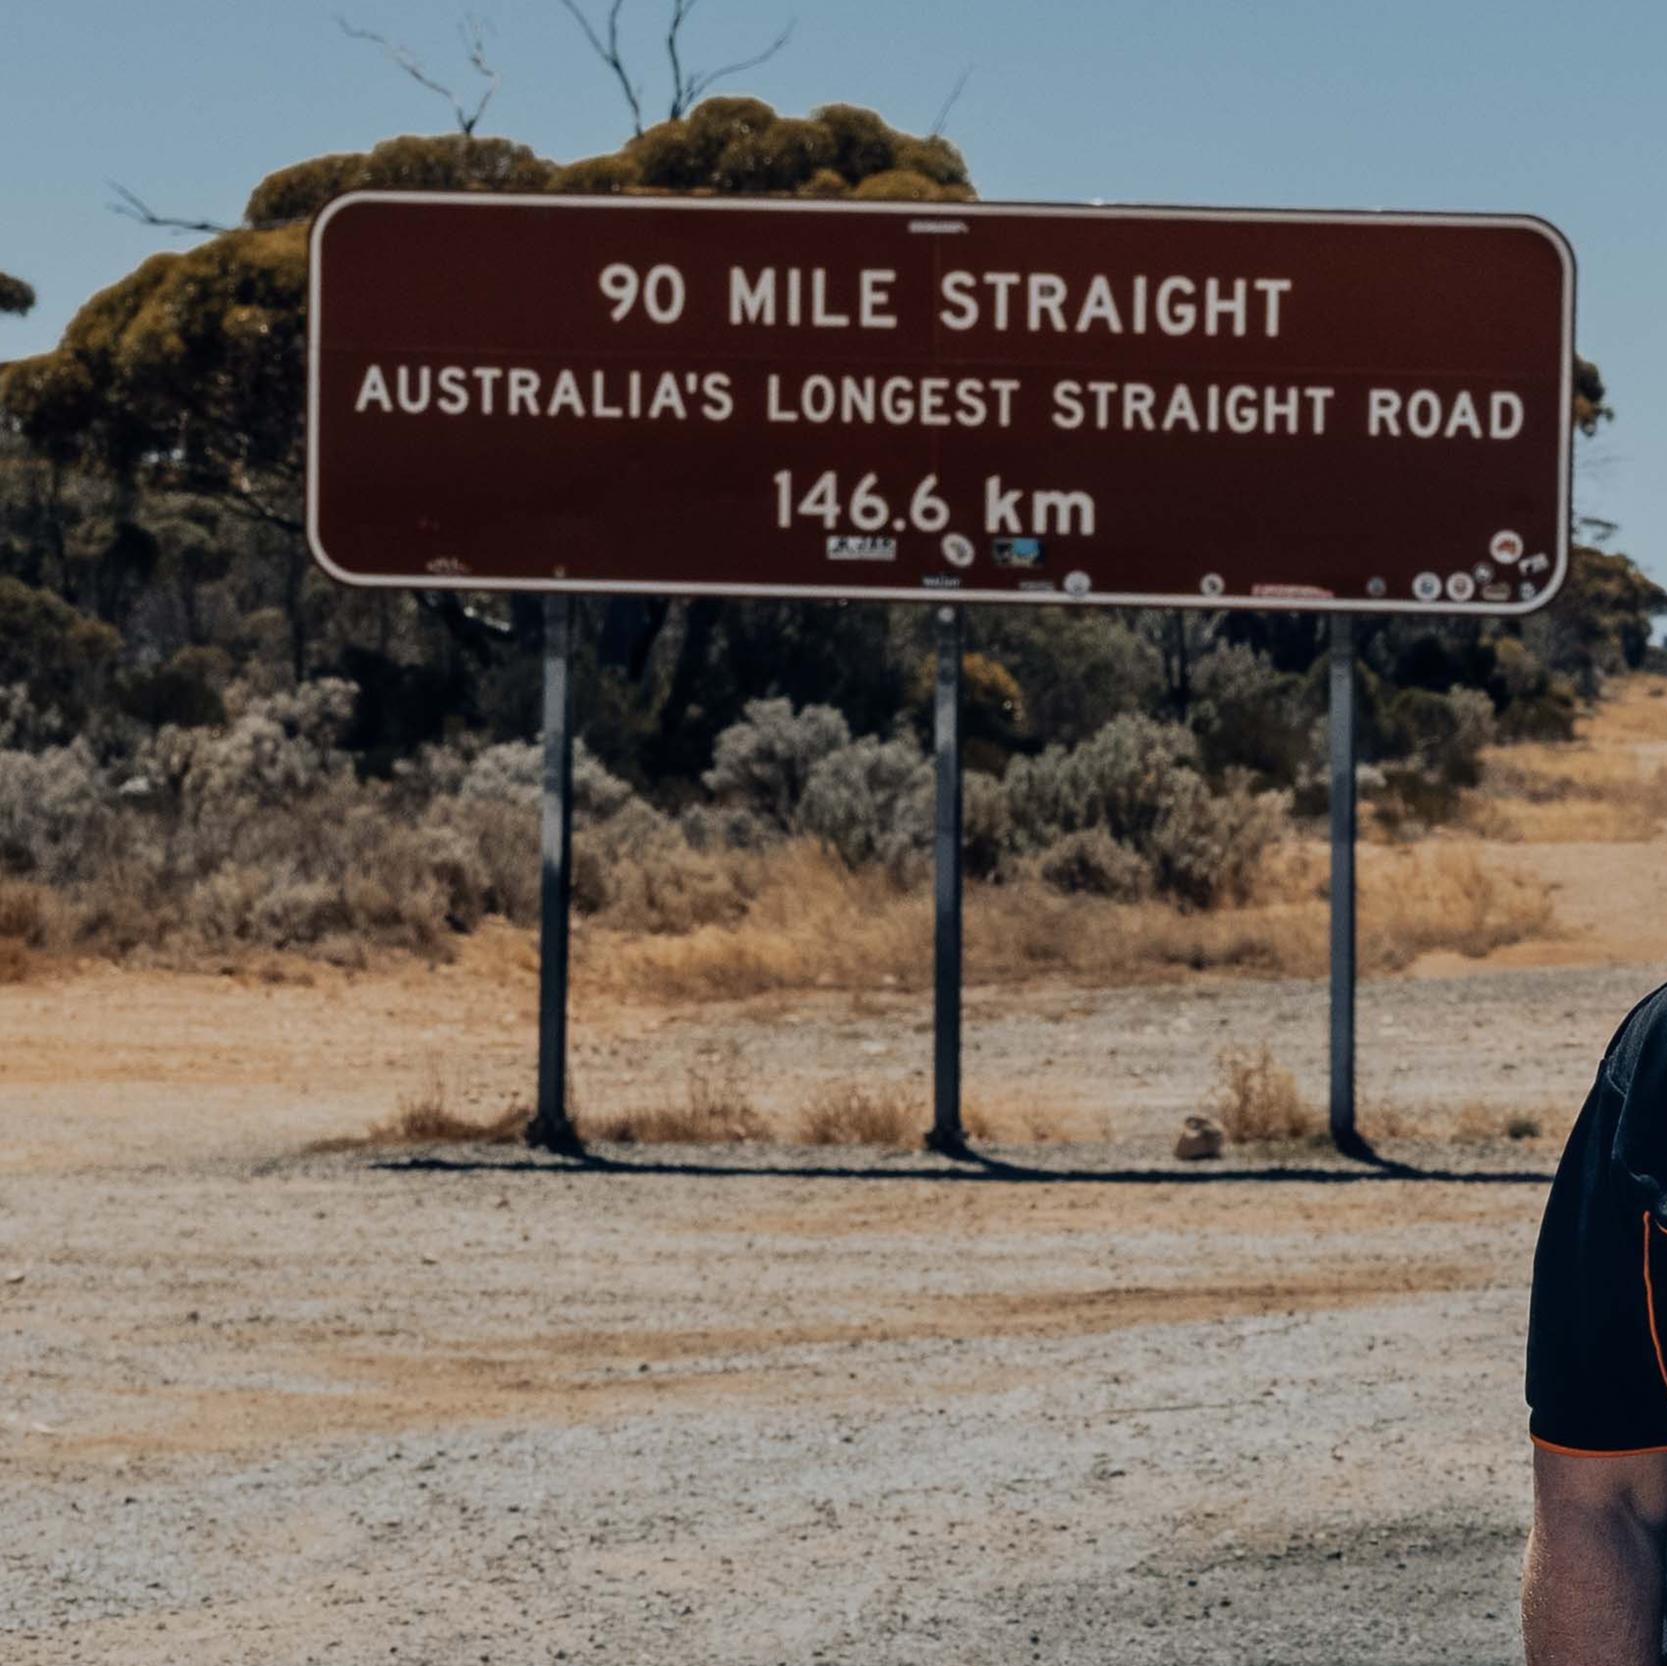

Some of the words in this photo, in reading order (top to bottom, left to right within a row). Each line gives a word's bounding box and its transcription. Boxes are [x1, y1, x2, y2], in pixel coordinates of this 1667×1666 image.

[598, 262, 687, 324] 90
[728, 266, 898, 329] MILE
[938, 270, 1293, 337] STRAIGHT
[354, 363, 735, 422] AUSTRALIA'S
[766, 374, 1021, 428] LONGEST
[1051, 380, 1335, 436] STRAIGHT
[1366, 388, 1525, 440] ROAD
[773, 470, 950, 532] 146.6
[984, 475, 1095, 536] km
